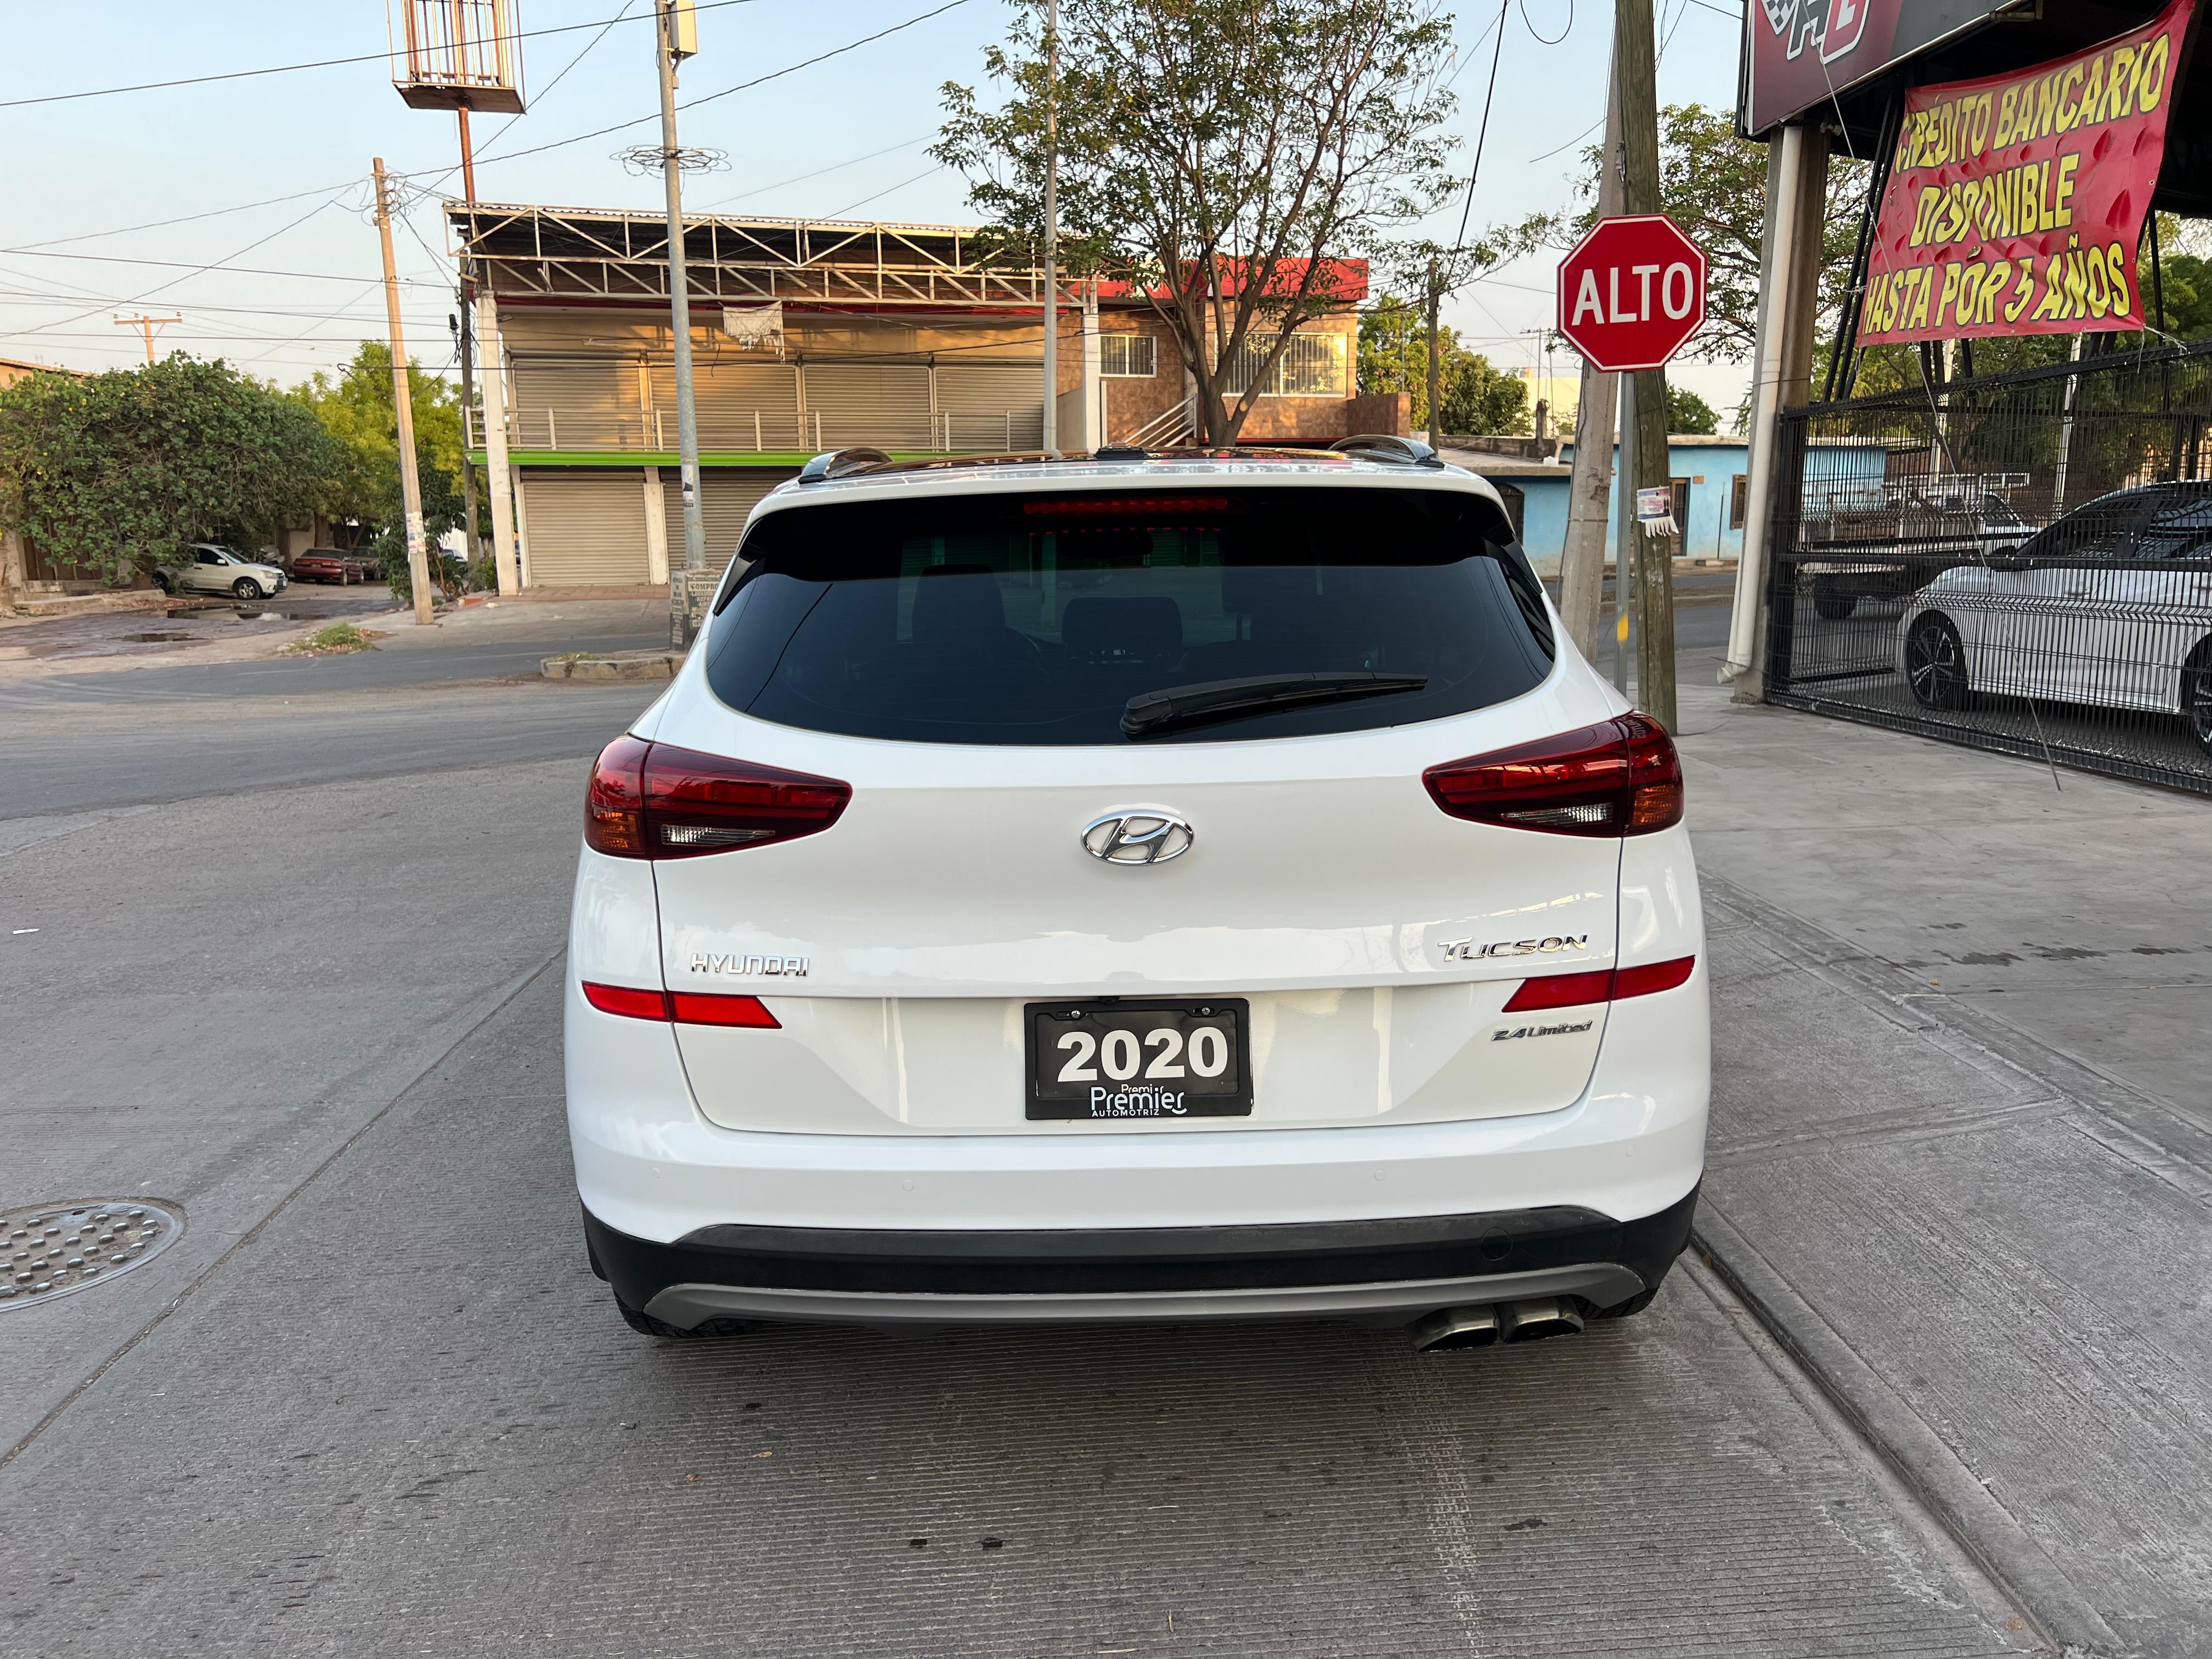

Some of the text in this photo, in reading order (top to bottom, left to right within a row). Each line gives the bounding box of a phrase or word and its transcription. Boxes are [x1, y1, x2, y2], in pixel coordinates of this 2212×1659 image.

[1993, 33, 2170, 150] BANCARIO
[1909, 153, 2080, 248] DISPONIBLE
[1571, 262, 1694, 326] ALTO
[1863, 233, 2130, 335] HASTA POR 5 AÑOS
[691, 953, 810, 977] HYUNDAI
[1437, 934, 1588, 962] TUCSON
[1527, 1019, 1593, 1037] Limited
[1057, 1026, 1228, 1082] 2020
[1091, 1086, 1186, 1111] Premier
[1091, 1108, 1160, 1118] AUTOMOTRIZ
